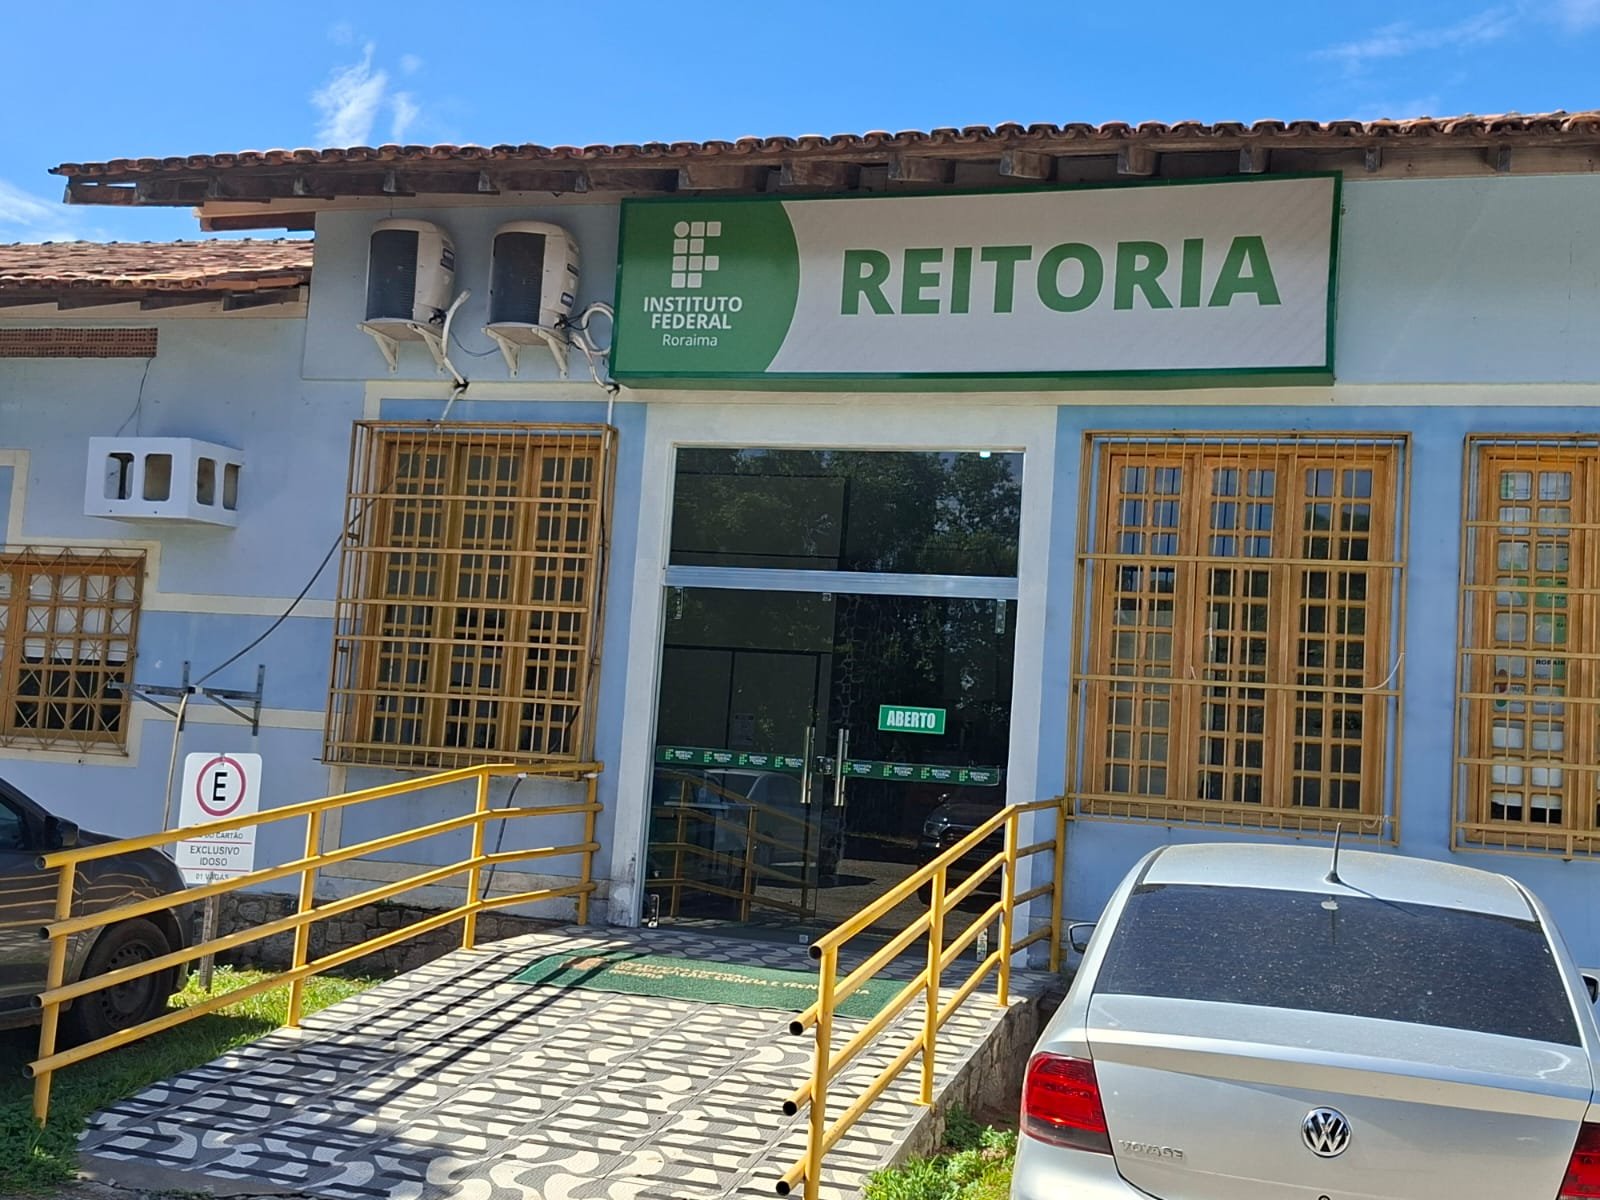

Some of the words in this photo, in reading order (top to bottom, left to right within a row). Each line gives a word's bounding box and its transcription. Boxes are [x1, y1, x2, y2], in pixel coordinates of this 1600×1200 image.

[841, 235, 1281, 316] REITORIA
[643, 296, 743, 312] INSTITUTO
[651, 313, 732, 329] FEDERAL
[662, 334, 718, 346] Roraima
[887, 709, 936, 729] ABERTO
[212, 772, 228, 801] E
[190, 845, 240, 855] EXCLUSIVO
[199, 857, 228, 866] IDOSO
[1118, 1139, 1184, 1160] VOYAGE
